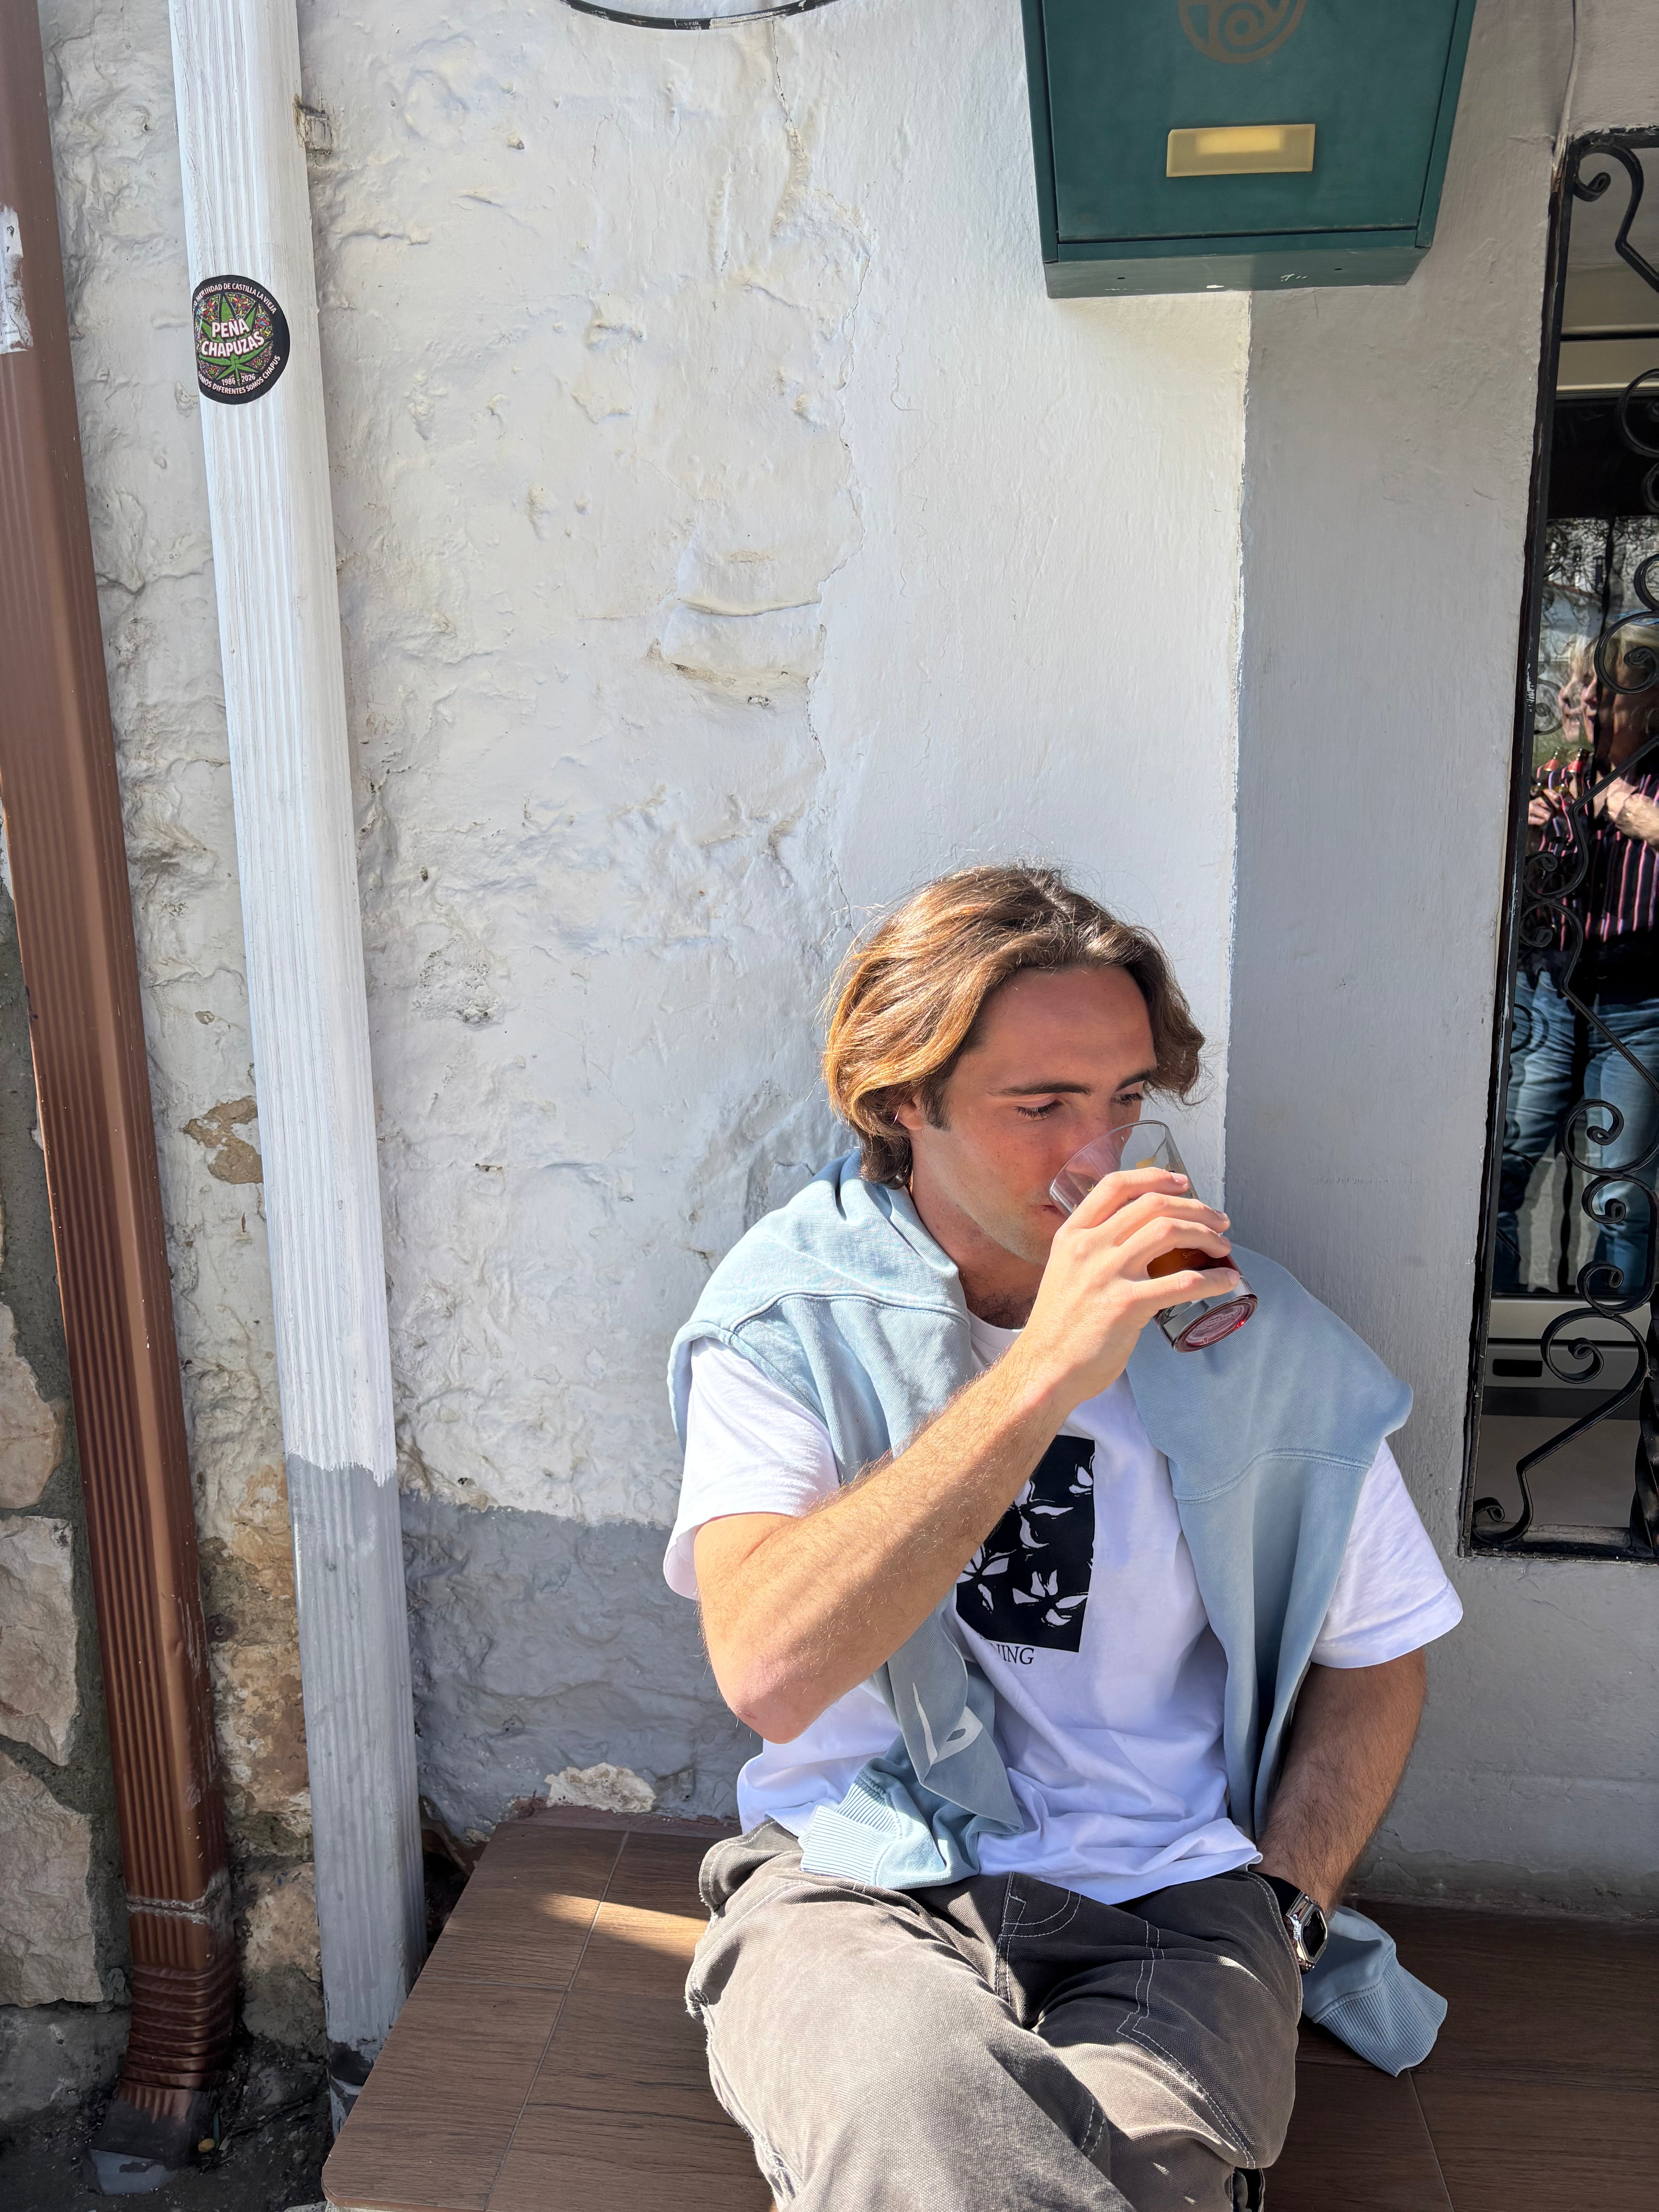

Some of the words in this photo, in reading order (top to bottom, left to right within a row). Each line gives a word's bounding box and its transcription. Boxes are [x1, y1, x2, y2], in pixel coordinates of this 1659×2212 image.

[232, 283, 256, 296] CASTILLA
[256, 291, 264, 300] LA
[263, 296, 277, 315] VIEJA
[212, 318, 251, 338] PEÑA
[201, 331, 265, 357] CHAPUZAS
[212, 383, 246, 394] DIFERENTES
[245, 376, 264, 392] SOMOS
[262, 355, 280, 379] CHAPUS
[221, 378, 236, 386] 1986
[241, 373, 256, 383] 2026
